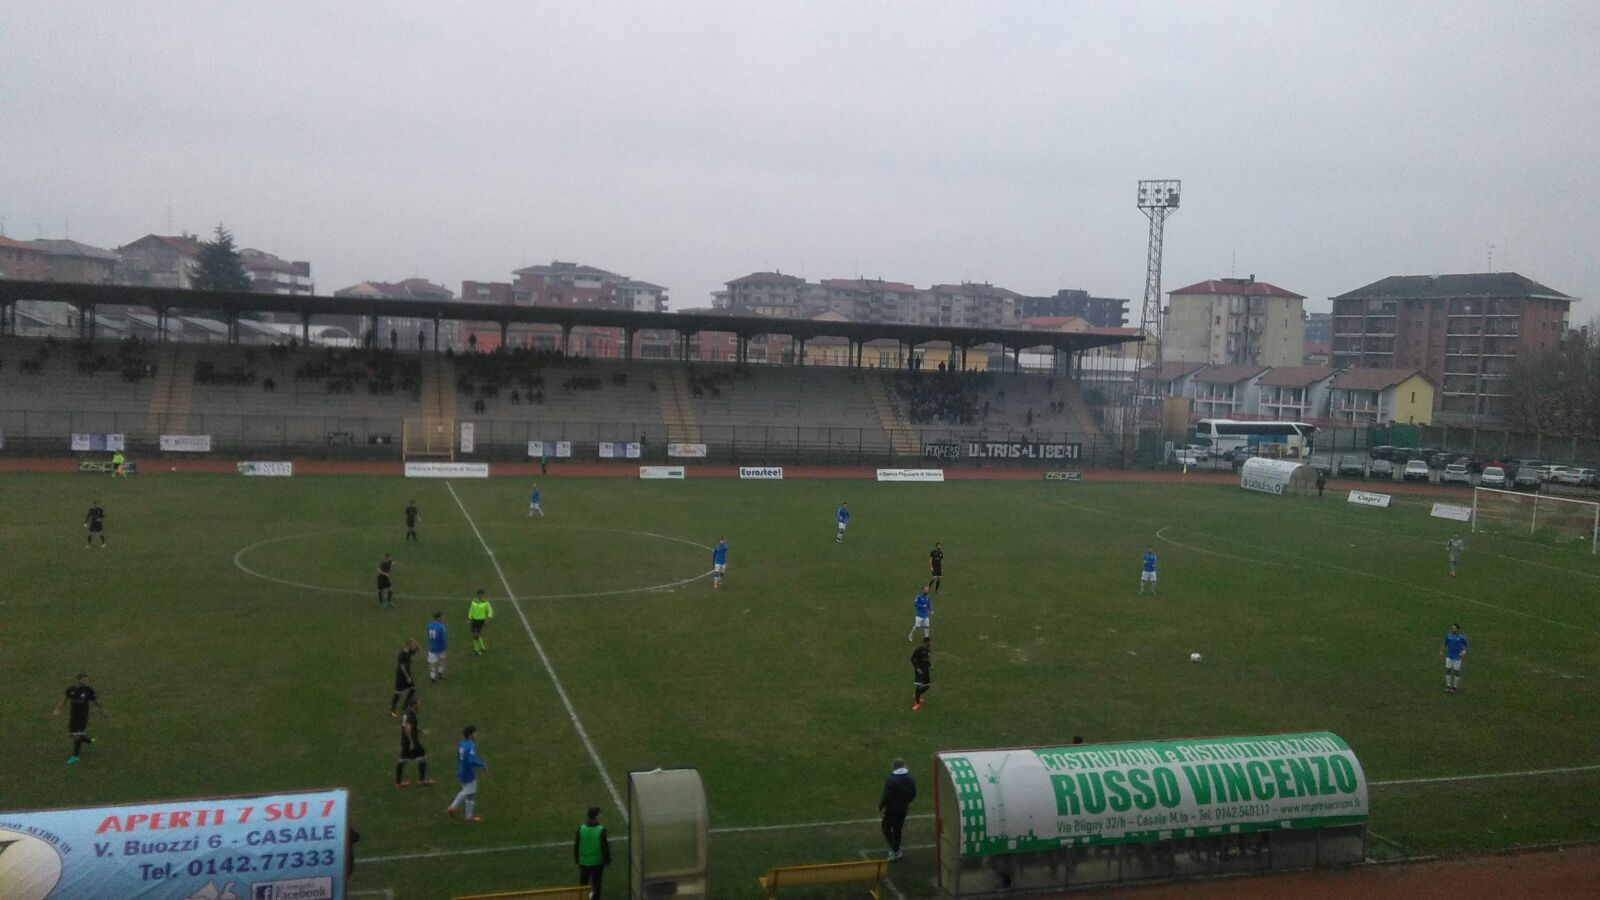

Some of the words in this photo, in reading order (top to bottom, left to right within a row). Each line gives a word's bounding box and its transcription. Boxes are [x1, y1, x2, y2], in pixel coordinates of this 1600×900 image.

[1028, 445, 1078, 458] LIBERI
[740, 467, 782, 477] Eurosteel
[1357, 494, 1380, 502] Capri
[1038, 748, 1162, 771] COSTRUZIONI
[1165, 751, 1178, 761] e
[1176, 736, 1341, 763] RISTRUTTURAZIONI
[1050, 767, 1181, 816] RUSSO
[1182, 754, 1358, 805] VINCENZO
[95, 806, 224, 834] APERTI
[237, 807, 254, 824] 7
[264, 801, 307, 822] SU
[320, 799, 335, 817] 7
[1057, 821, 1072, 833] Via
[1074, 819, 1103, 834] Bligny
[1106, 818, 1126, 829] 32/h
[1137, 814, 1167, 826] Casale
[93, 842, 114, 857] V.
[124, 835, 199, 857] Buozzi
[208, 834, 222, 849] 6
[246, 825, 336, 847] CASALE
[139, 863, 177, 881] Tel.
[187, 849, 335, 876] 0142.77333
